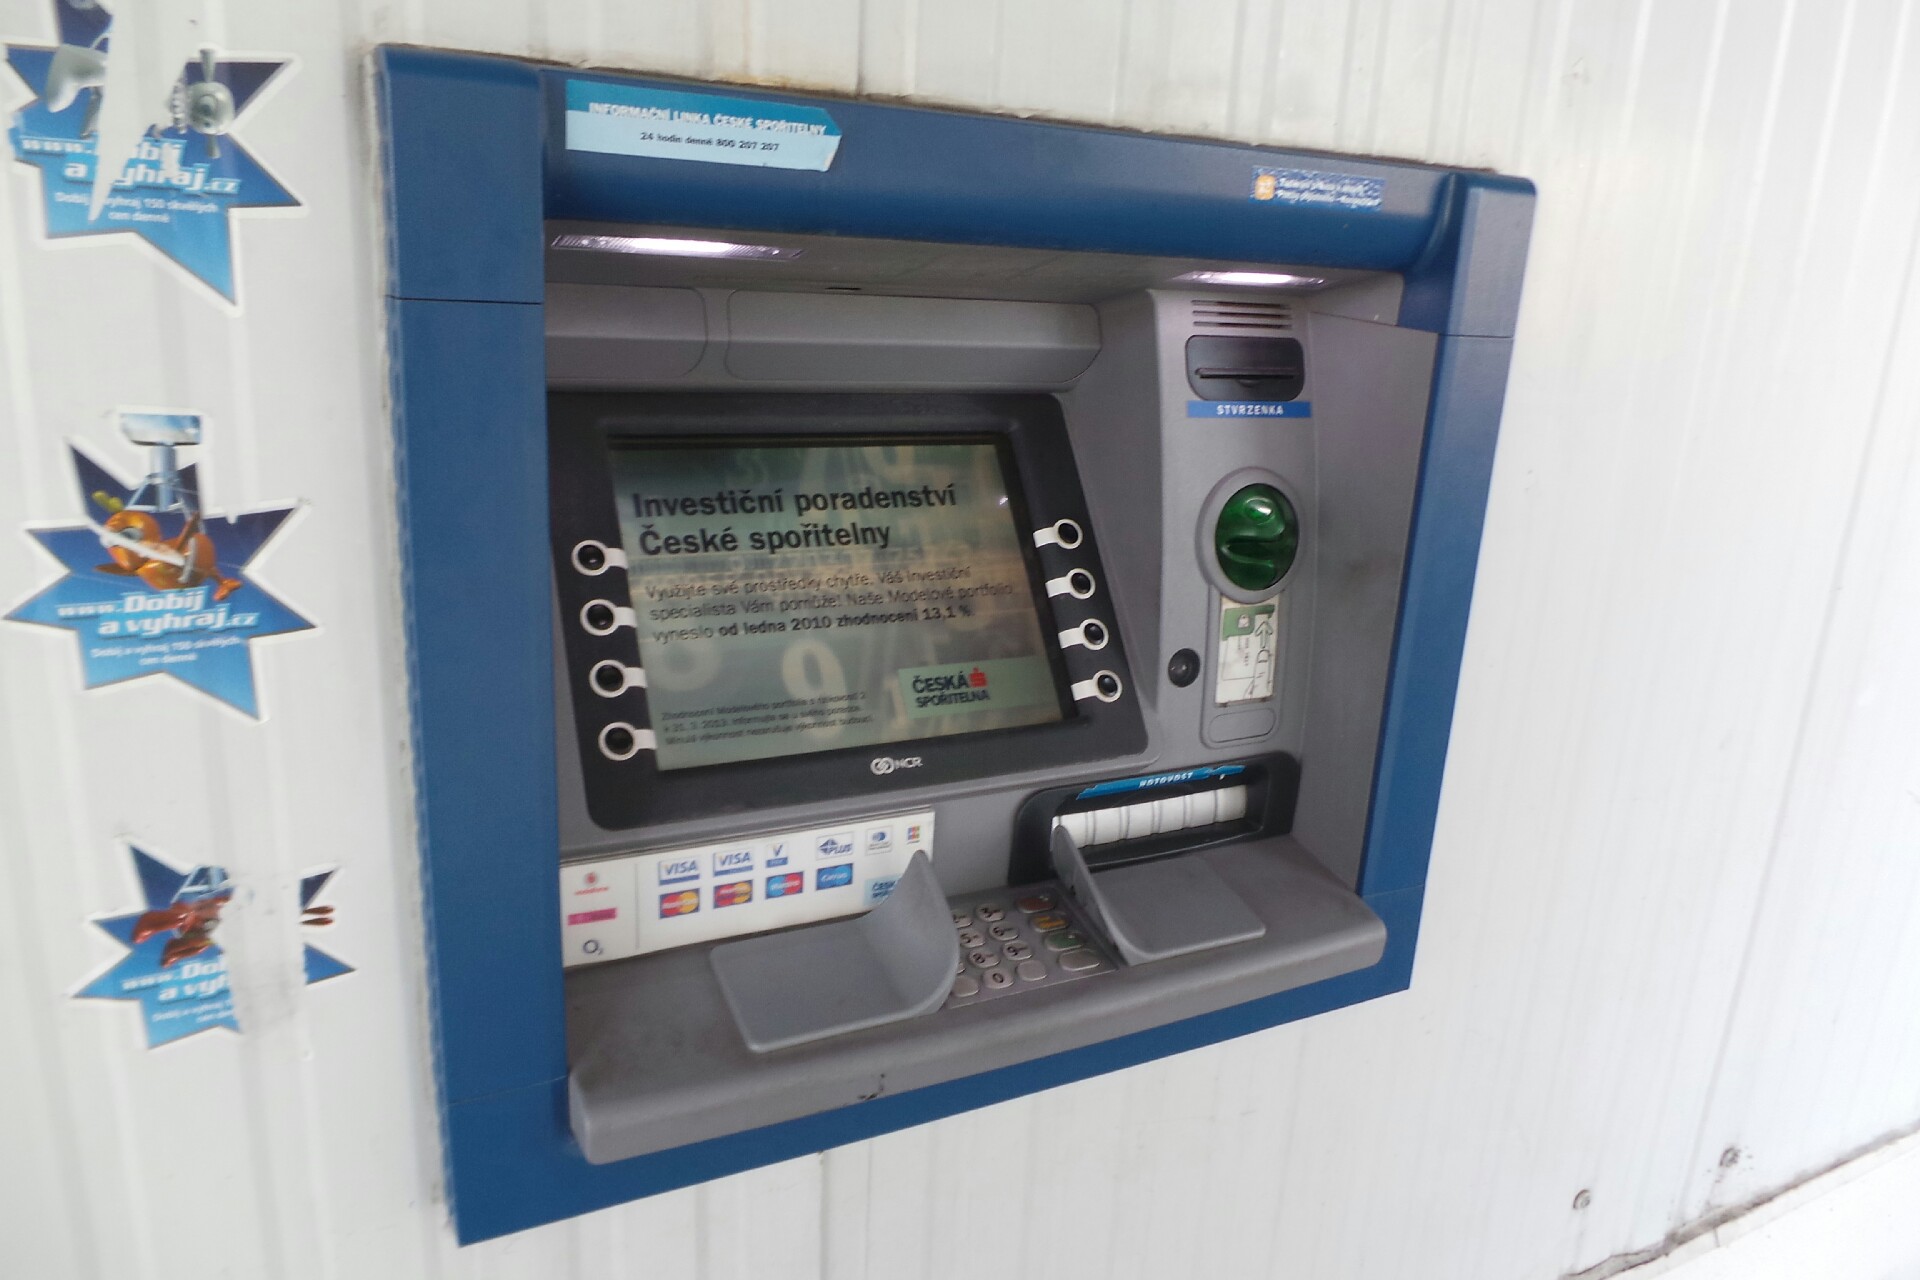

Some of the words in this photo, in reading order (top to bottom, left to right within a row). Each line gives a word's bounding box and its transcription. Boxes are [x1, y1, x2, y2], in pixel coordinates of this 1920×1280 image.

[673, 111, 710, 124] LINKA
[713, 113, 753, 129] ČESKÉ
[640, 132, 654, 141] 24
[64, 162, 87, 179] a
[1217, 404, 1284, 415] STVRZENKA
[633, 488, 783, 518] Investiční
[795, 483, 956, 517] poradenství
[639, 524, 739, 556] České
[750, 522, 890, 554] spořitelny
[650, 602, 736, 620] specialista
[99, 620, 120, 635] a
[126, 605, 258, 636] vyhraj.cz
[652, 625, 713, 645] vyneslo
[719, 623, 738, 637] od
[743, 620, 786, 635] ledna
[790, 615, 832, 631] 2010
[912, 671, 969, 693] ČESKÁ
[915, 689, 990, 708] SPOŘITELNA
[666, 860, 697, 876] VISA
[720, 851, 751, 867] VISA
[992, 972, 1004, 984] 0
